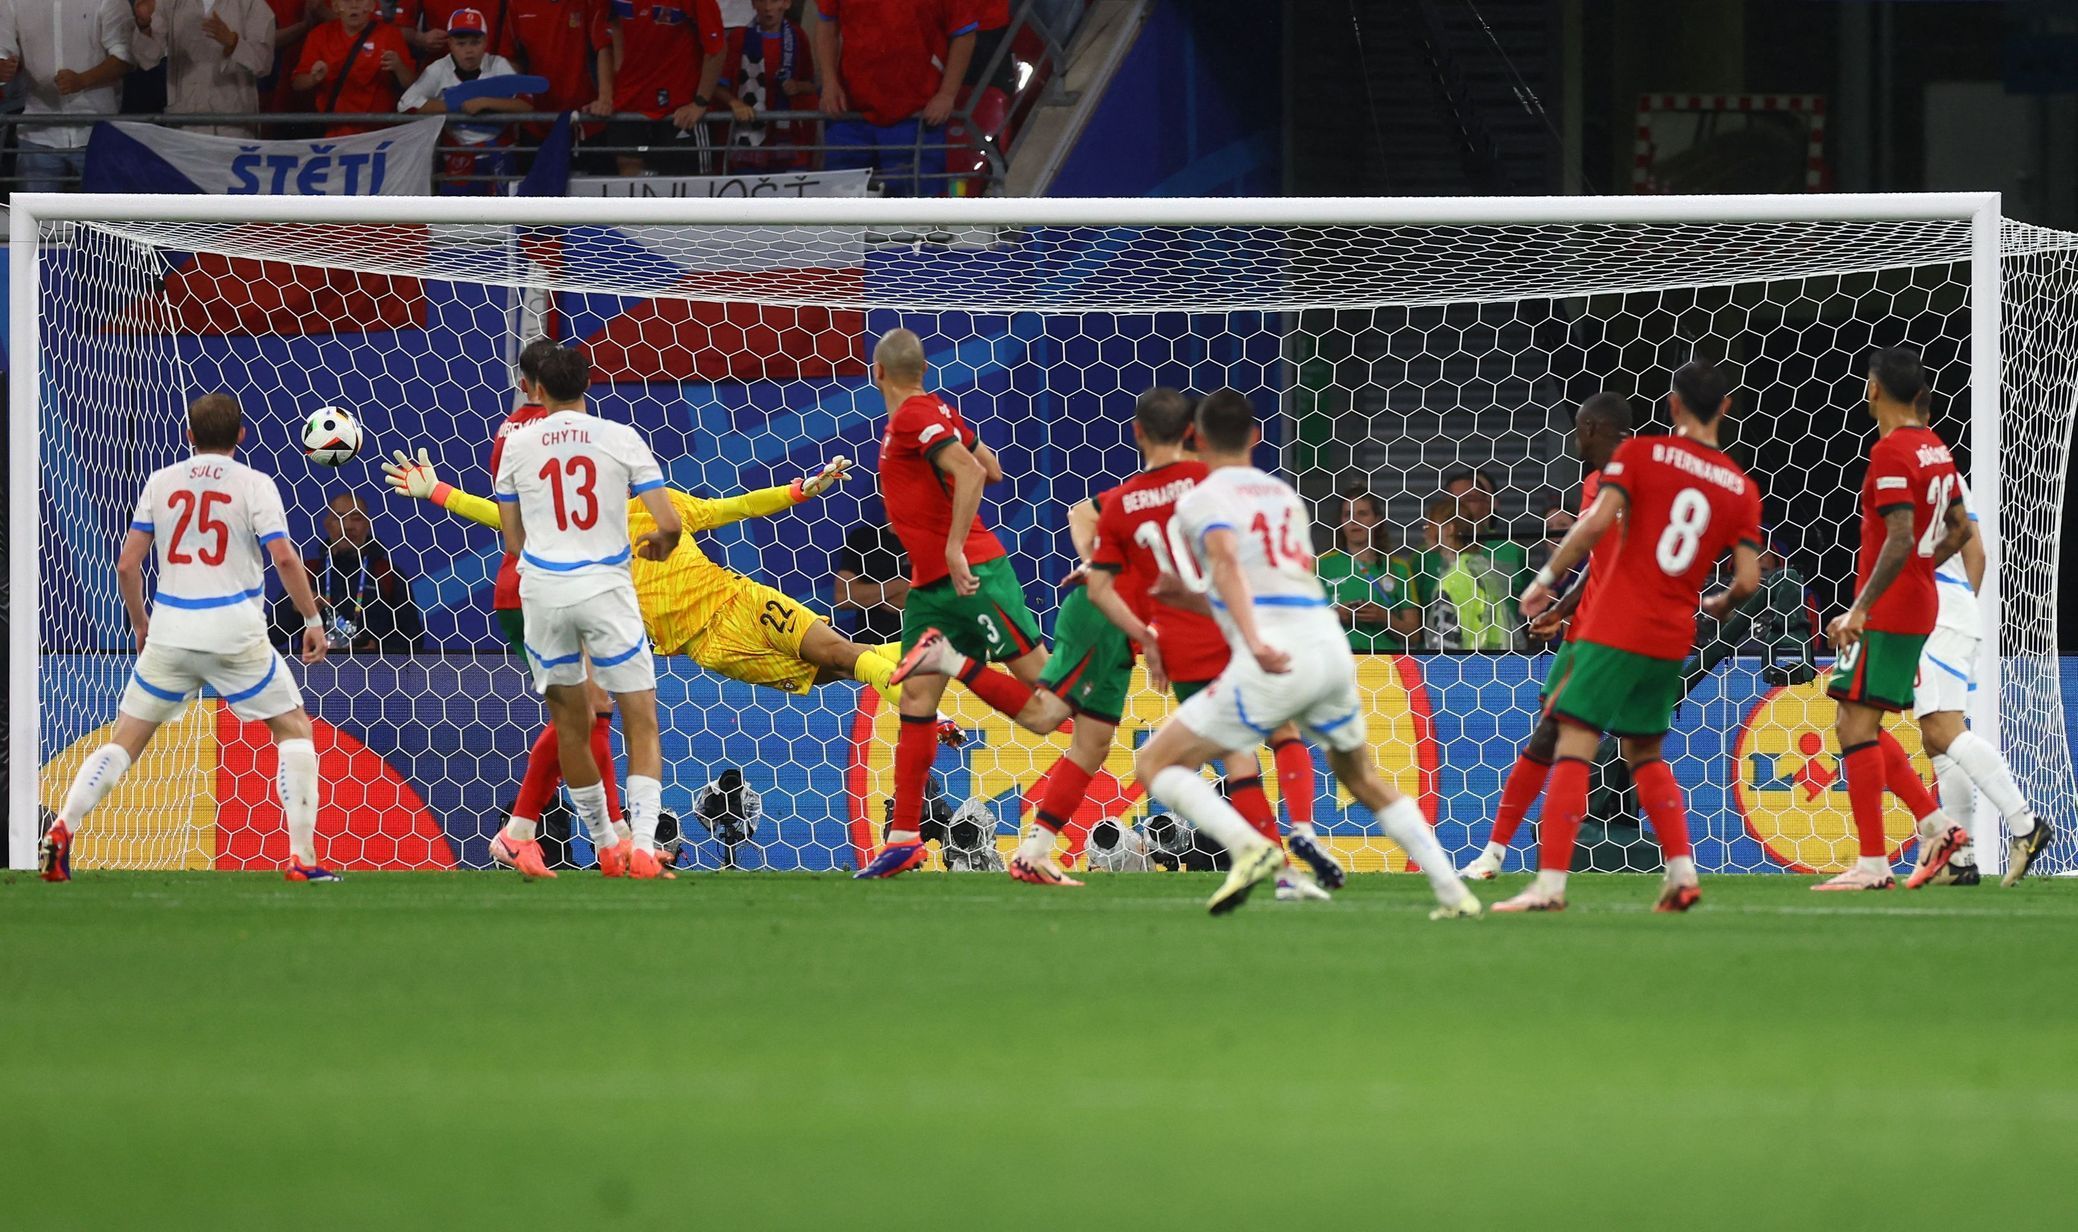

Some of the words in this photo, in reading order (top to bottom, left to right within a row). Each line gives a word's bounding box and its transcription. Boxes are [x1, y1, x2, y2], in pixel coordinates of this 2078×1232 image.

[227, 141, 394, 196] ŠTĚTÍ
[541, 429, 592, 446] CHYTIL
[538, 455, 599, 532] 13
[1121, 477, 1195, 515] BERNARDO
[167, 489, 232, 567] 25
[1133, 515, 1212, 594] 10
[1655, 487, 1712, 577] 8
[760, 600, 795, 634] 22
[977, 613, 1001, 644] 3
